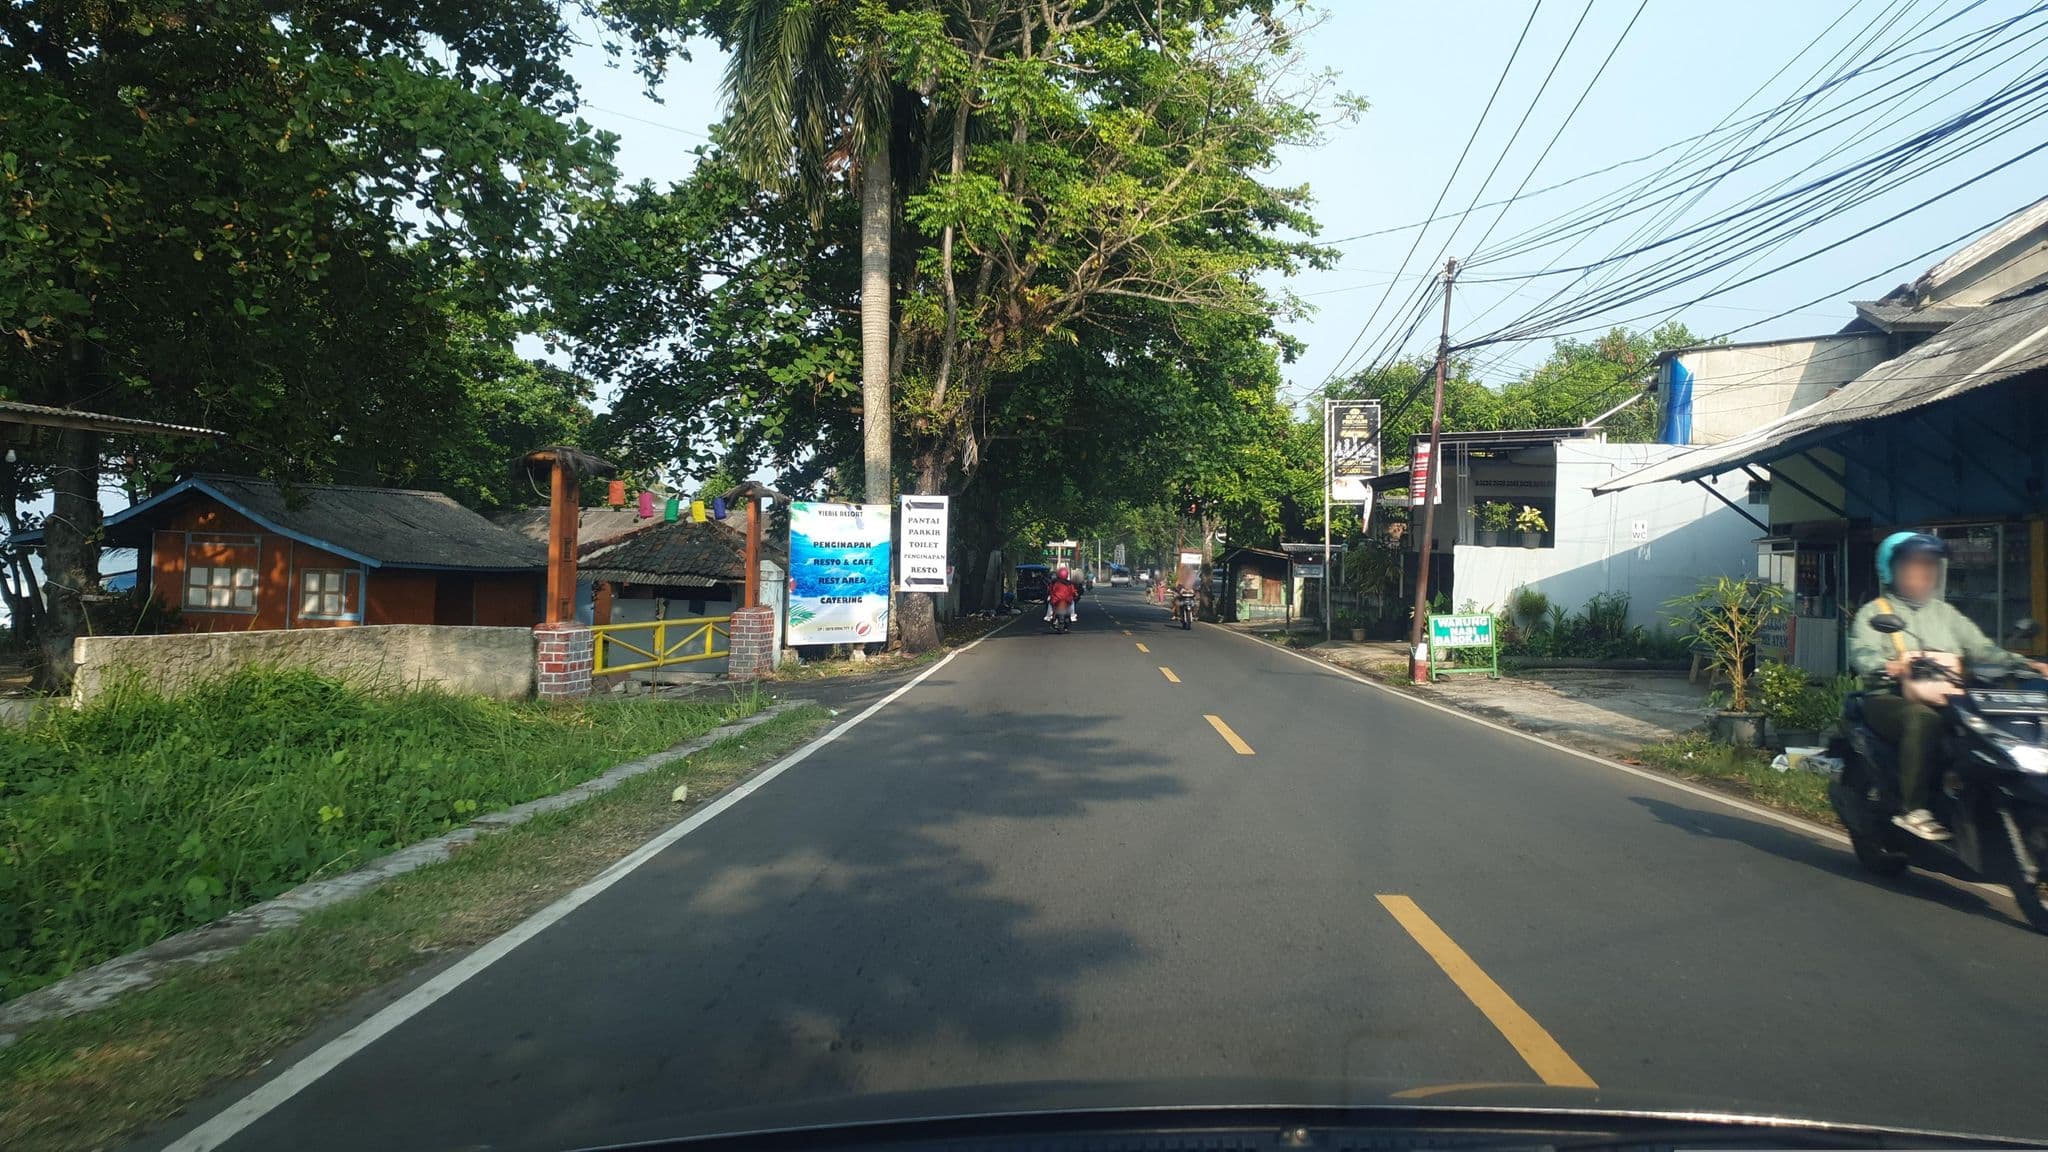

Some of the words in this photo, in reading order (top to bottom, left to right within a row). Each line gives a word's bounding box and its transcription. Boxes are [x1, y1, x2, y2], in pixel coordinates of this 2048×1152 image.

[908, 517, 940, 525] PANTAI
[820, 596, 863, 604] CATERING
[1437, 618, 1488, 628] WARUNG
[1450, 626, 1477, 635] NASI
